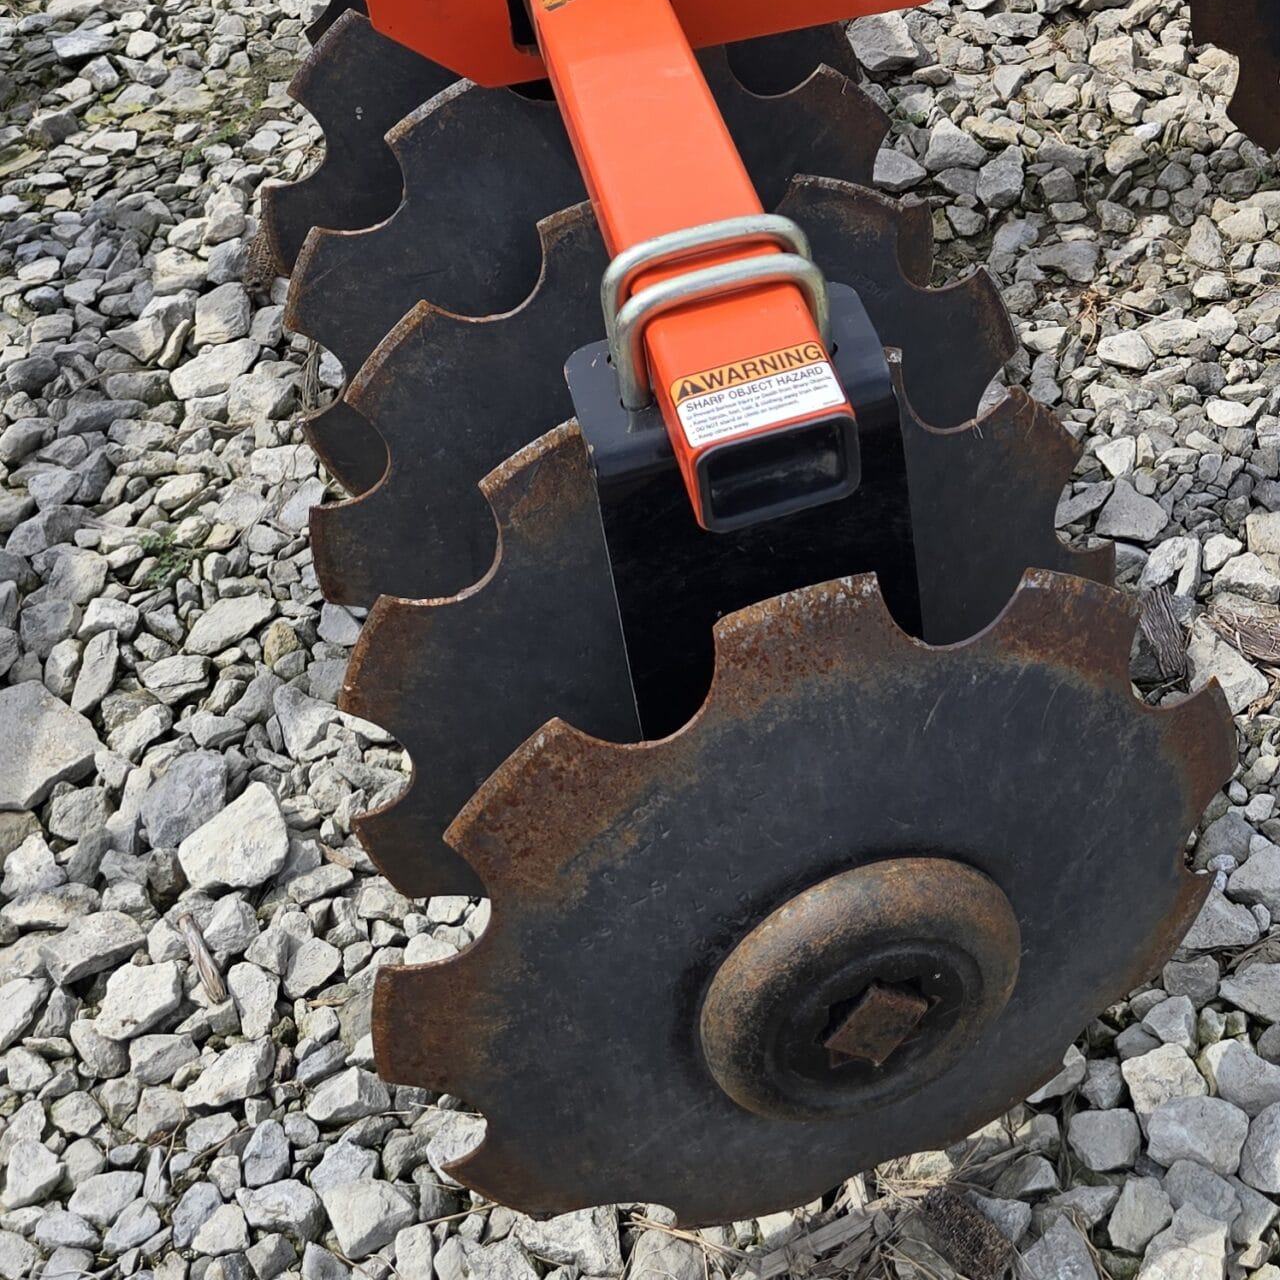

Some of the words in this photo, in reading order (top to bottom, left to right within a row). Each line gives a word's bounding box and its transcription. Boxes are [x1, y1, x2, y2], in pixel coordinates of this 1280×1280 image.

[686, 393, 725, 412] SHARP
[728, 379, 773, 400] OBJECT
[776, 366, 823, 387] HAZARD
[700, 344, 823, 389] WARNING
